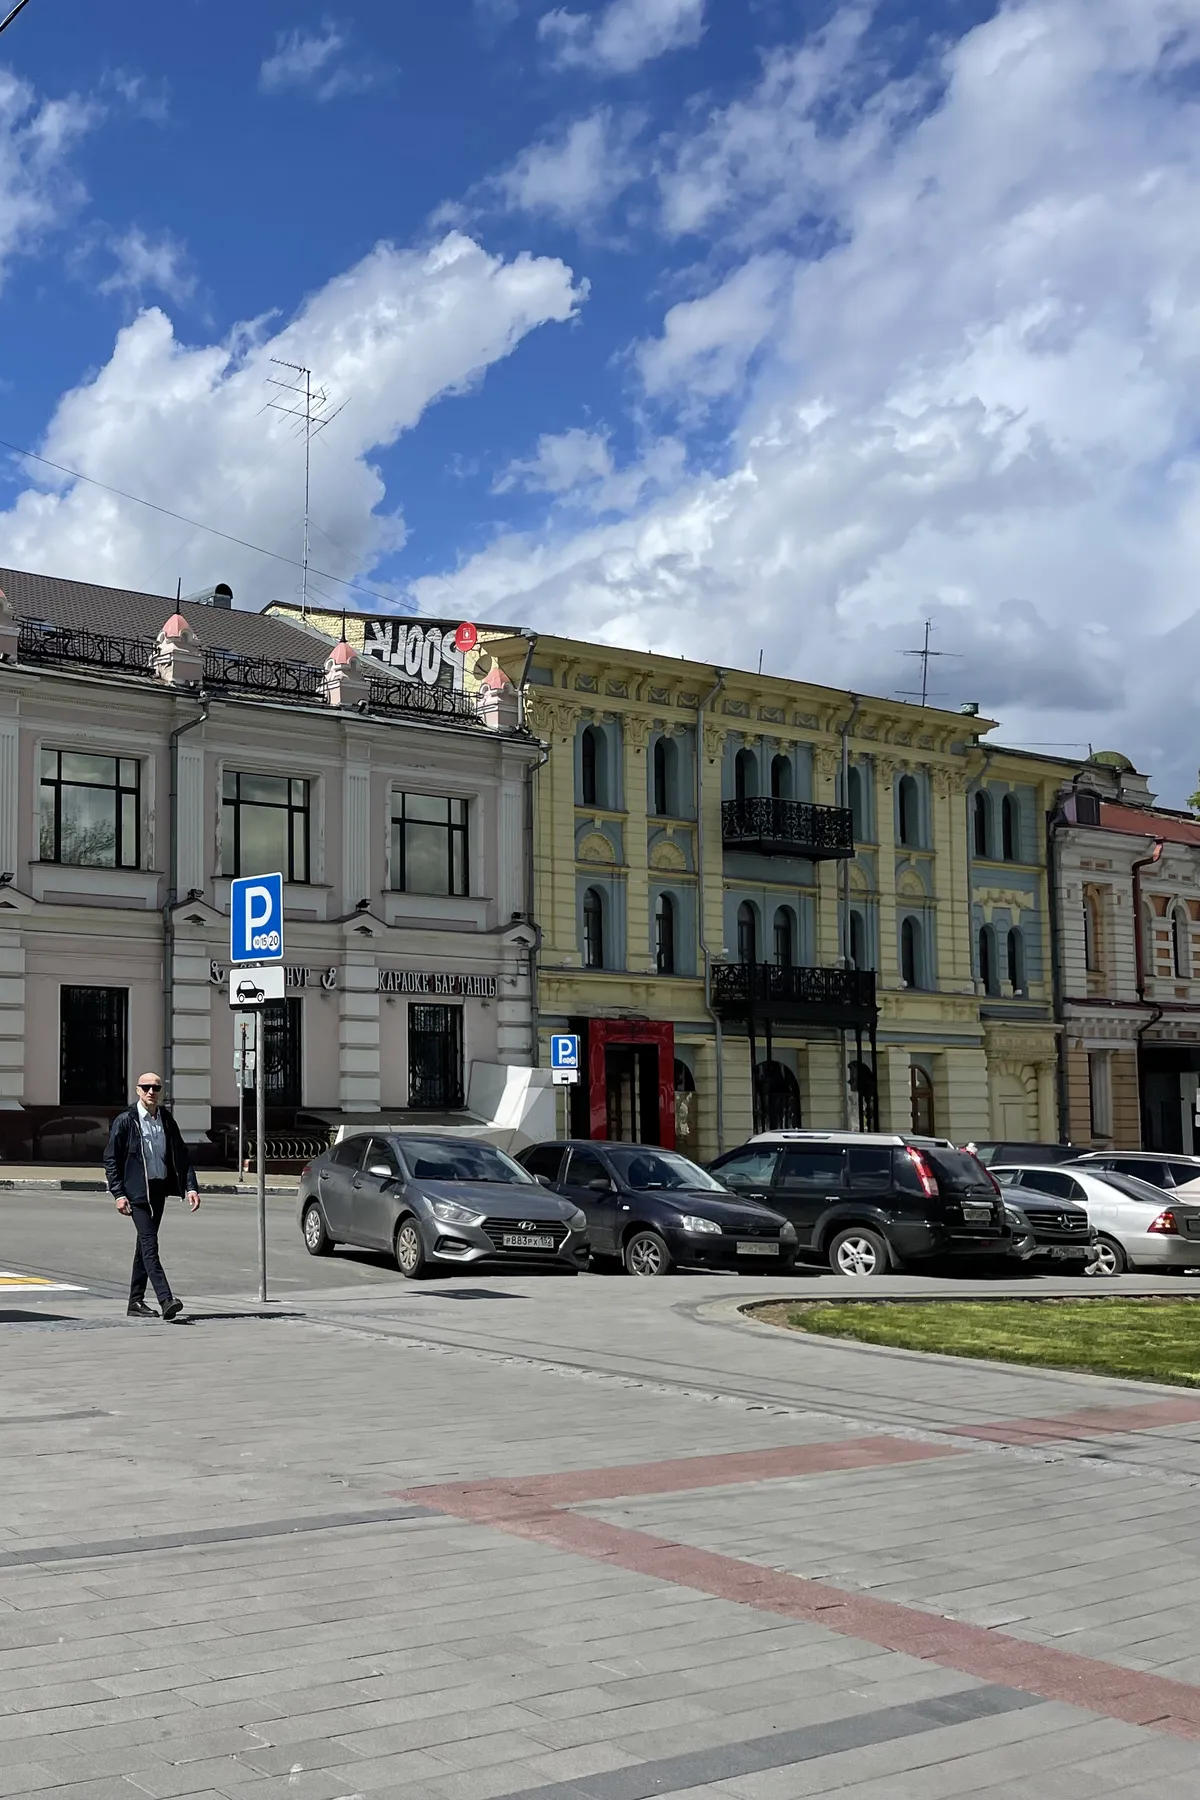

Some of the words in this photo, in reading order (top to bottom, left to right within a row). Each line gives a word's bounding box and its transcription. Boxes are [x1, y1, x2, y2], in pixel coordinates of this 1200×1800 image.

[245, 886, 273, 951] P
[261, 937, 268, 946] 15
[269, 935, 279, 946] 20
[378, 971, 429, 993] КАРАОКЕ
[435, 973, 455, 994] БАР
[458, 975, 498, 997] ТАНЦЫ
[558, 1038, 573, 1064] P
